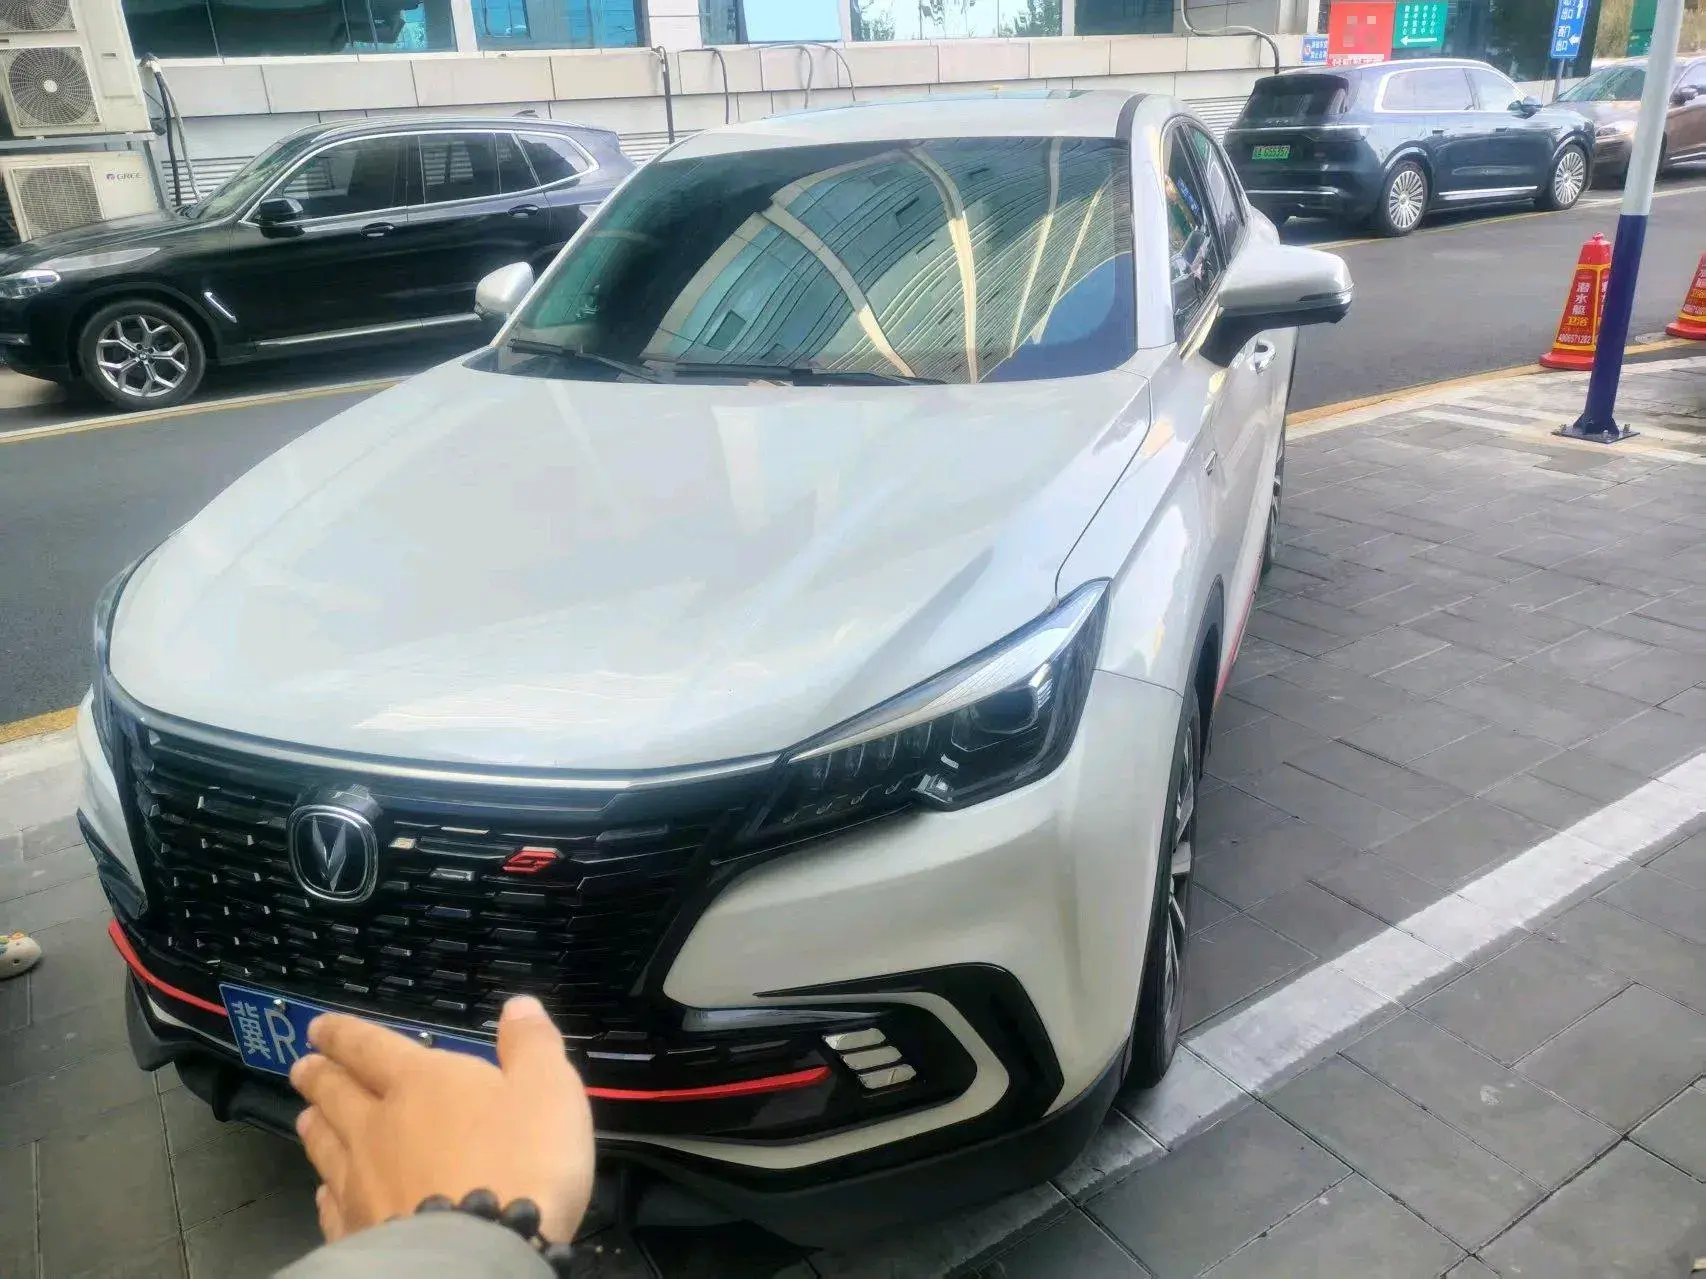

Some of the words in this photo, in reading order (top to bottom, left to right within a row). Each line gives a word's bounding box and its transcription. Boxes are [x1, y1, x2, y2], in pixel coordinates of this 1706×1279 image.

[116, 172, 143, 180] GREE
[1572, 282, 1590, 315] 潜水艇
